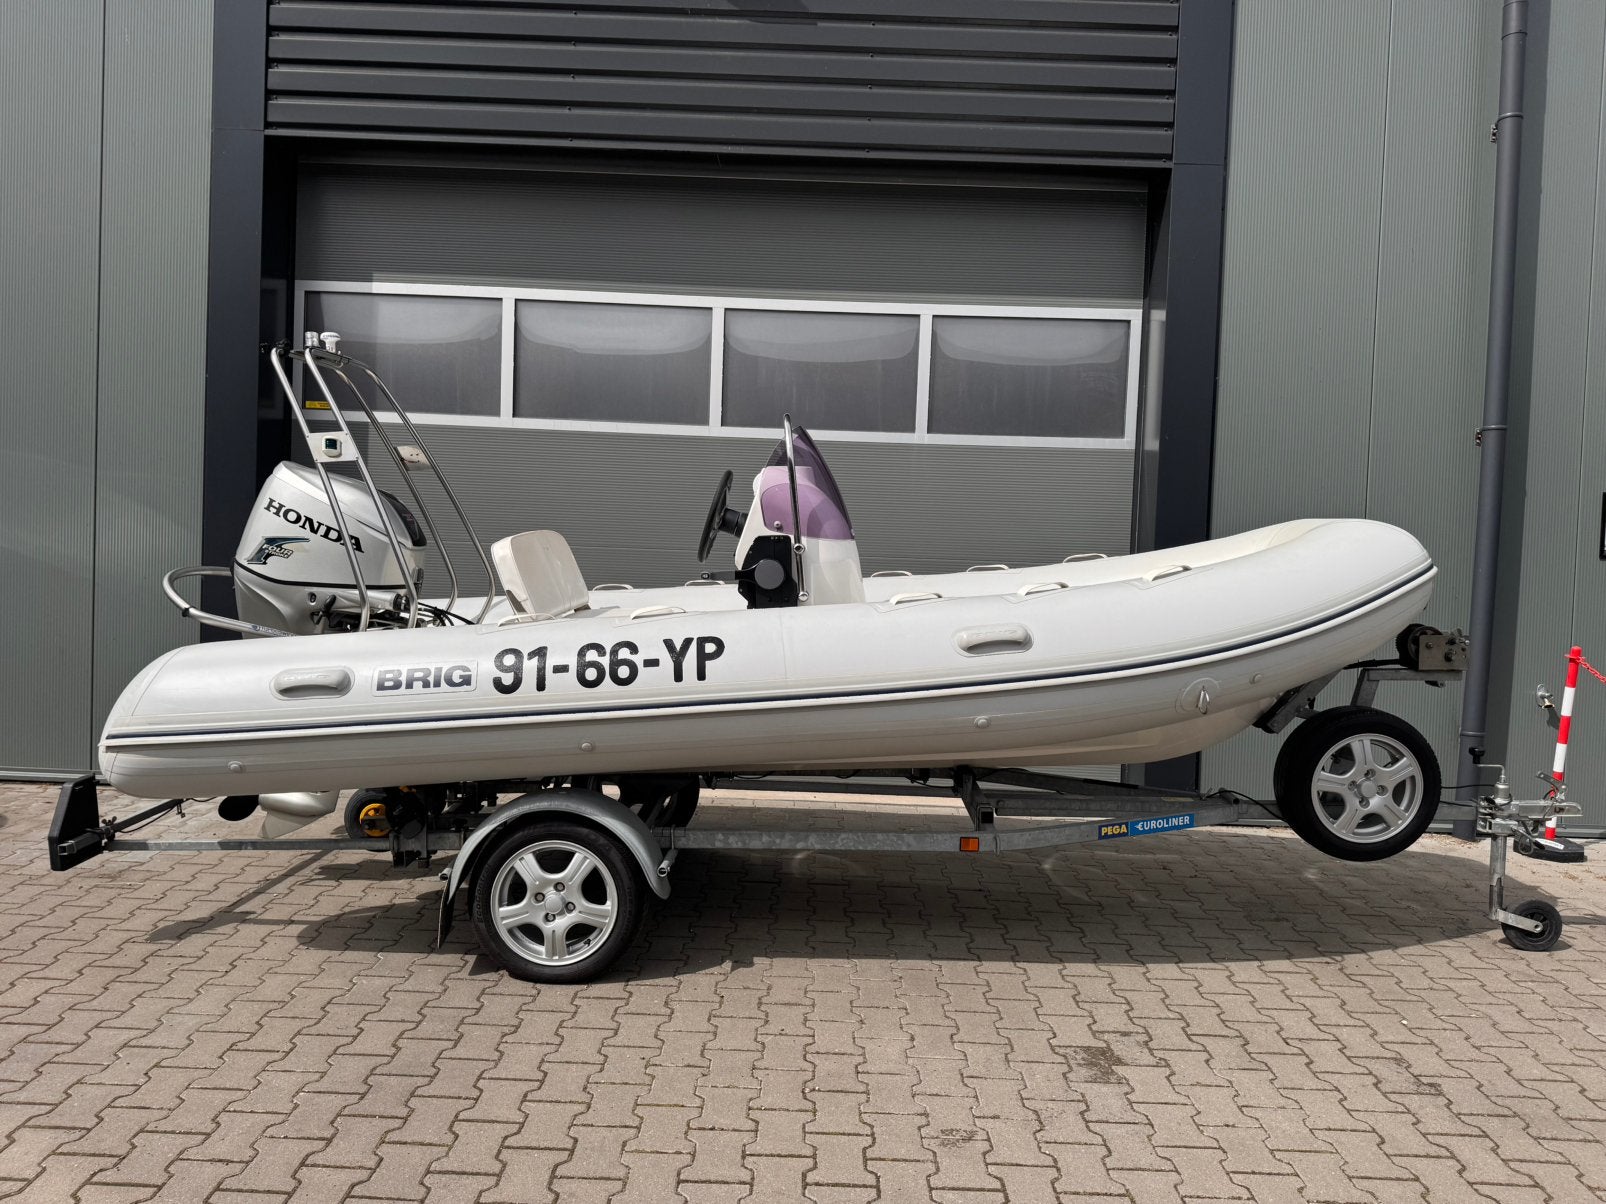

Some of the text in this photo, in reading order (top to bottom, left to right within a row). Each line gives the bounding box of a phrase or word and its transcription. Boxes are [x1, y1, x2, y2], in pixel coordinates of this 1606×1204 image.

[263, 497, 365, 554] HONDA
[376, 636, 726, 695] BRIG 91-66-YP
[1101, 824, 1128, 836] PEGA
